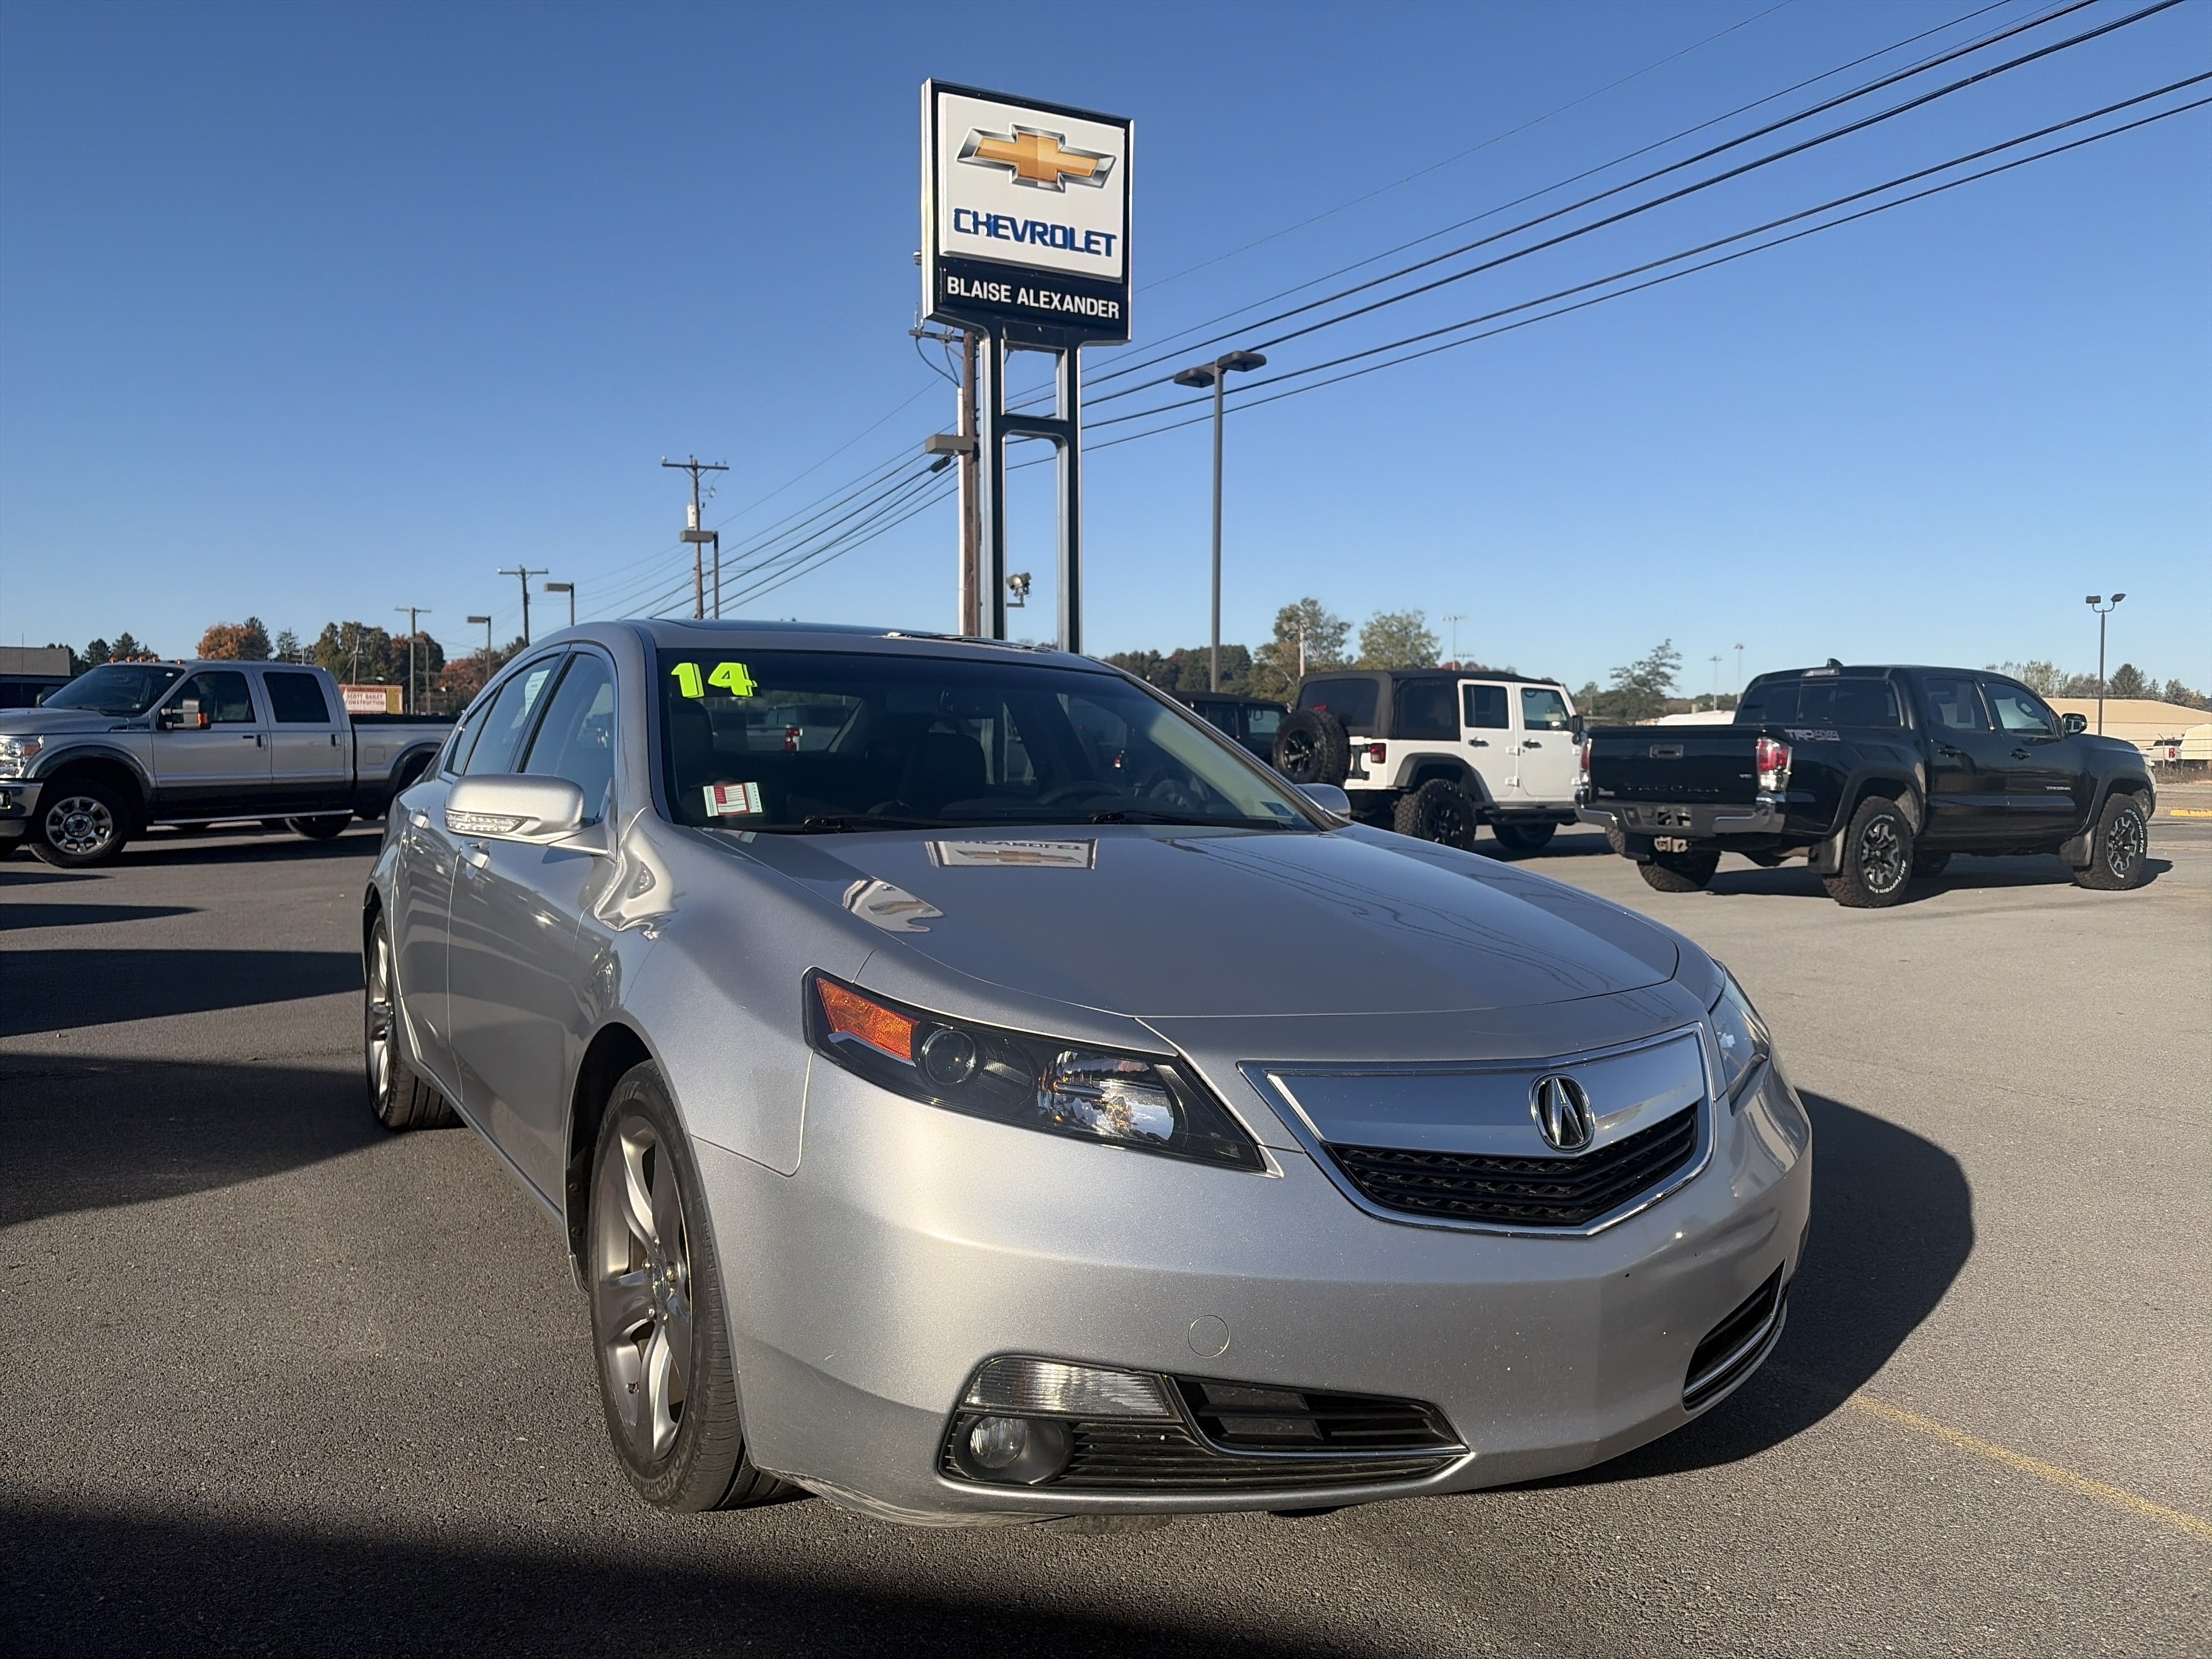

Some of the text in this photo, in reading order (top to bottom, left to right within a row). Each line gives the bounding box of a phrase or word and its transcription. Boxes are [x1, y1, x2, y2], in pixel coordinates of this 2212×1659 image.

[953, 207, 1118, 258] CHEVROLET
[947, 276, 1120, 319] BLAISE ALEXANDER
[671, 662, 757, 698] 14
